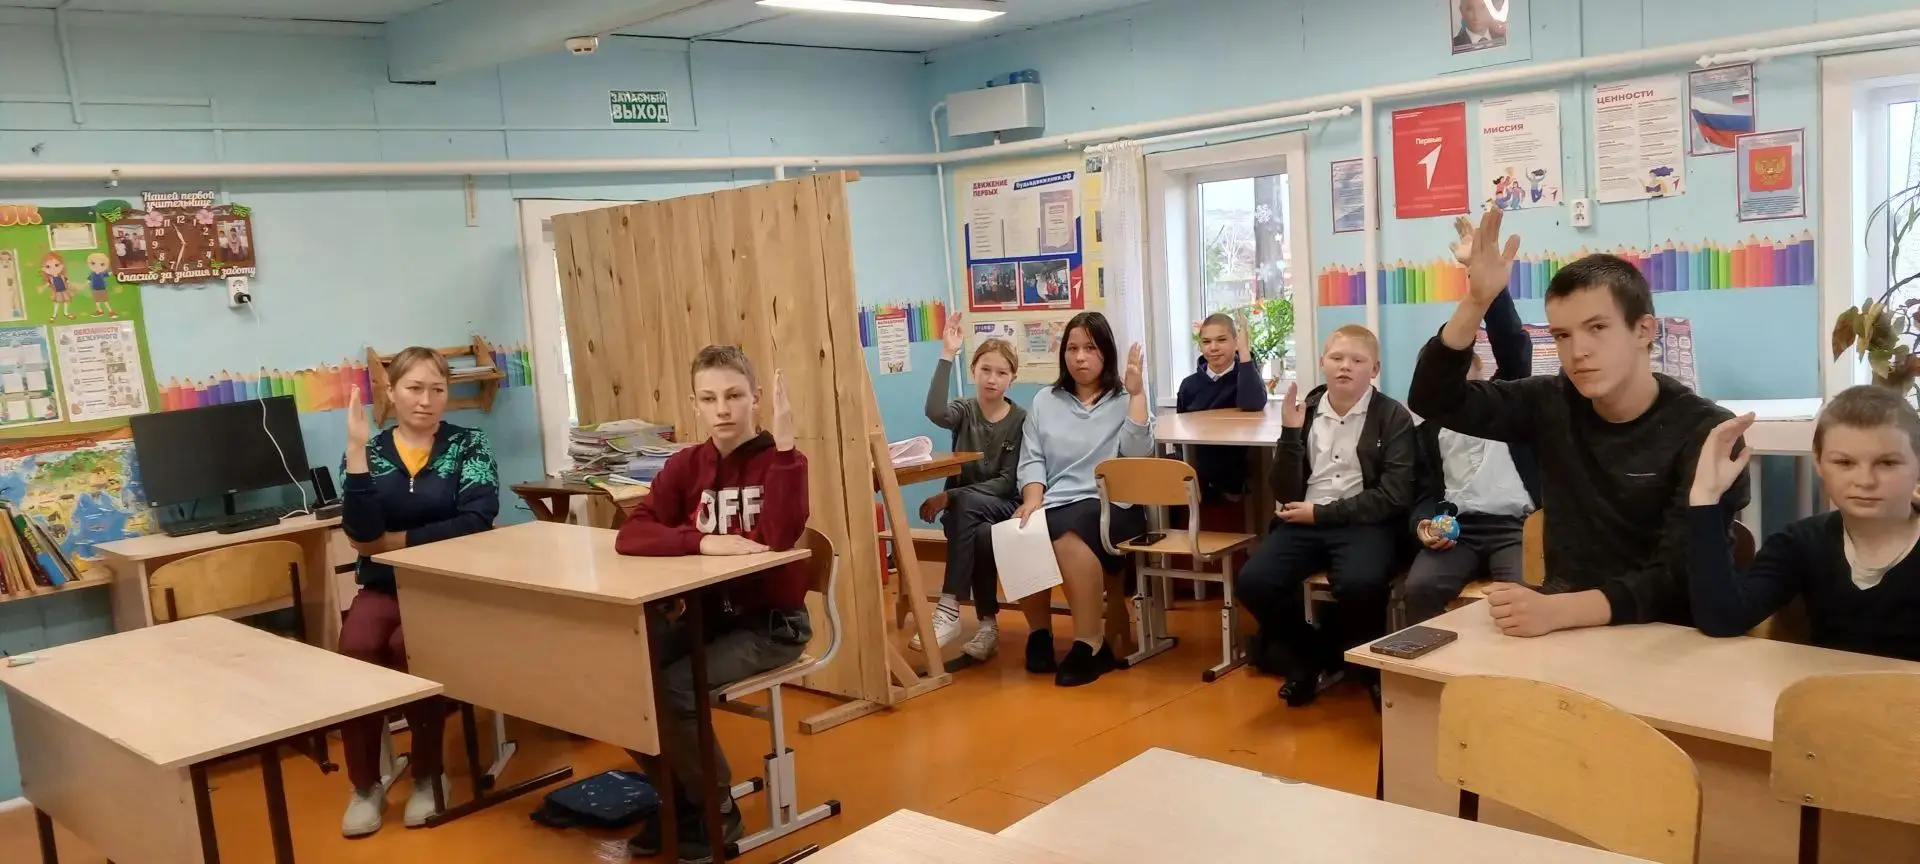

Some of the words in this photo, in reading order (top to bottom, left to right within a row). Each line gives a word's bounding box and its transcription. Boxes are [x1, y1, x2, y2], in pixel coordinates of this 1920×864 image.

[611, 91, 666, 103] ЗАПАСНЫЙ
[1597, 89, 1654, 104] ЦЕННОСТИ
[612, 103, 669, 122] ВЫХОД
[1483, 123, 1525, 134] МИССИЯ
[1415, 136, 1443, 146] Первые
[972, 179, 1008, 190] ДВИЖЕНИЕ
[142, 191, 179, 201] Нашей
[180, 190, 215, 202] первой
[972, 188, 999, 197] ПЕРВЫХ
[176, 215, 186, 224] 12
[155, 227, 165, 237] 10
[202, 226, 209, 236] 2
[151, 240, 159, 249] 9
[208, 238, 215, 247] 3
[158, 252, 165, 261] 8
[205, 250, 212, 260] 4
[169, 261, 176, 270] 7
[182, 263, 190, 272] 6
[196, 259, 203, 268] 5
[116, 271, 159, 282] Спасибо
[159, 271, 173, 284] за
[173, 269, 211, 283] знания
[212, 268, 220, 276] и
[220, 265, 256, 280] заботу
[696, 485, 764, 535] OFF
